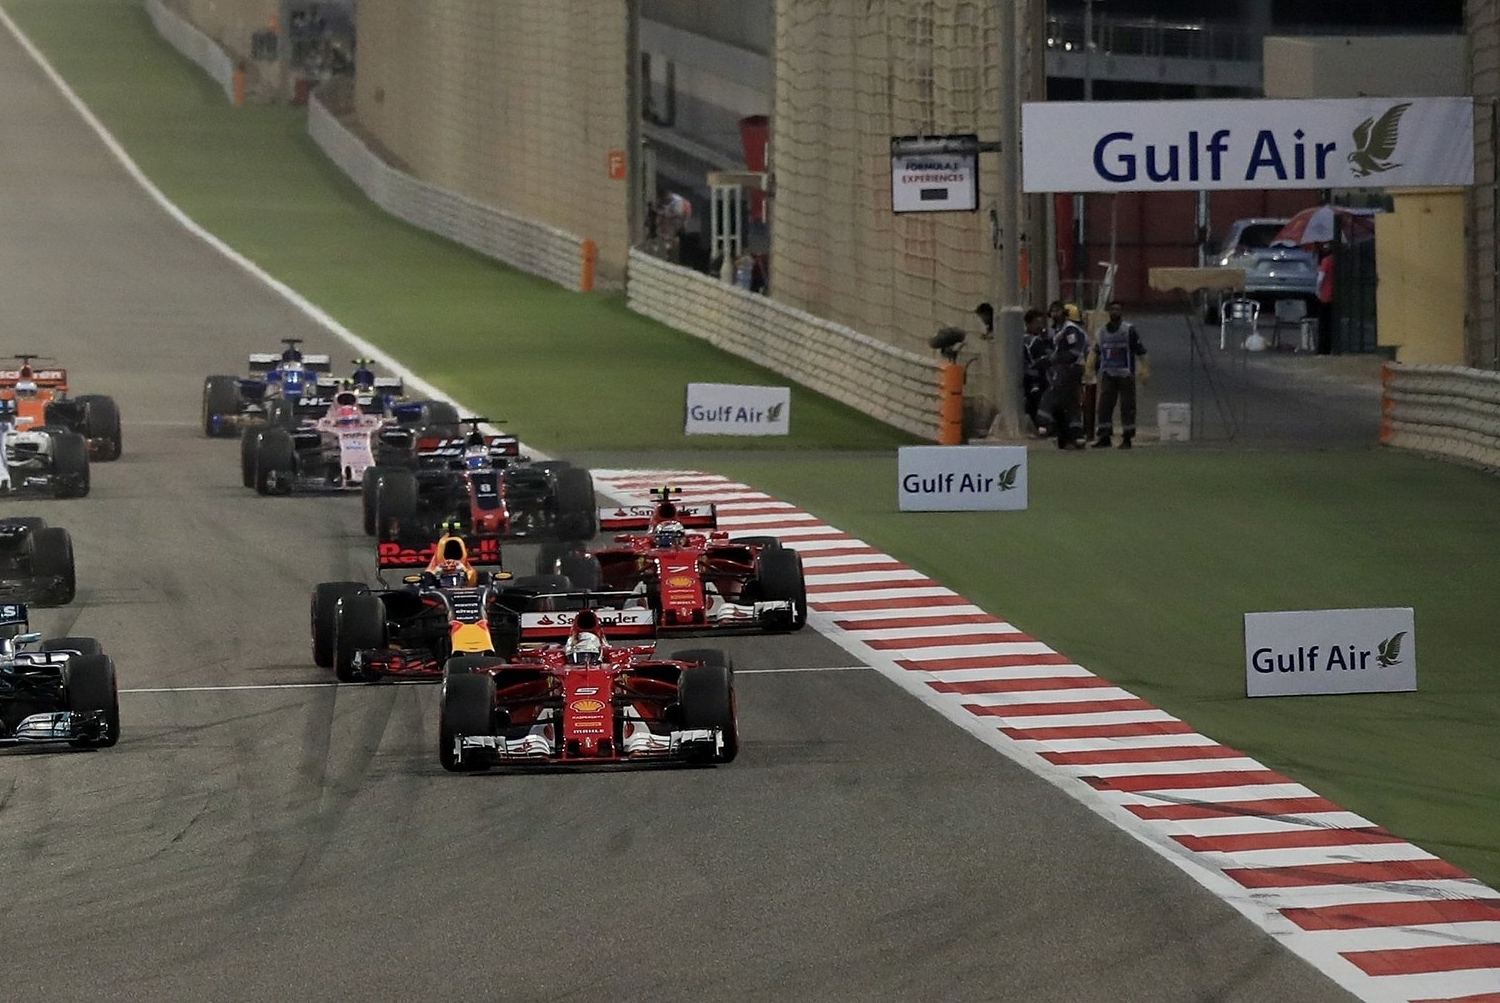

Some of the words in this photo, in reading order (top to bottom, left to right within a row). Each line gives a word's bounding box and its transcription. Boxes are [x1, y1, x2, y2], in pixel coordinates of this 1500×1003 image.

[1092, 128, 1231, 183] Gulf
[1245, 128, 1337, 182] Air
[902, 174, 965, 184] EXPERIENCES
[691, 405, 733, 422] Gulf
[735, 407, 763, 422] Air
[903, 473, 955, 494] Gulf
[959, 473, 994, 493] Air
[1252, 646, 1320, 674] Gulf
[1326, 644, 1371, 672] Air
[574, 687, 599, 695] 5
